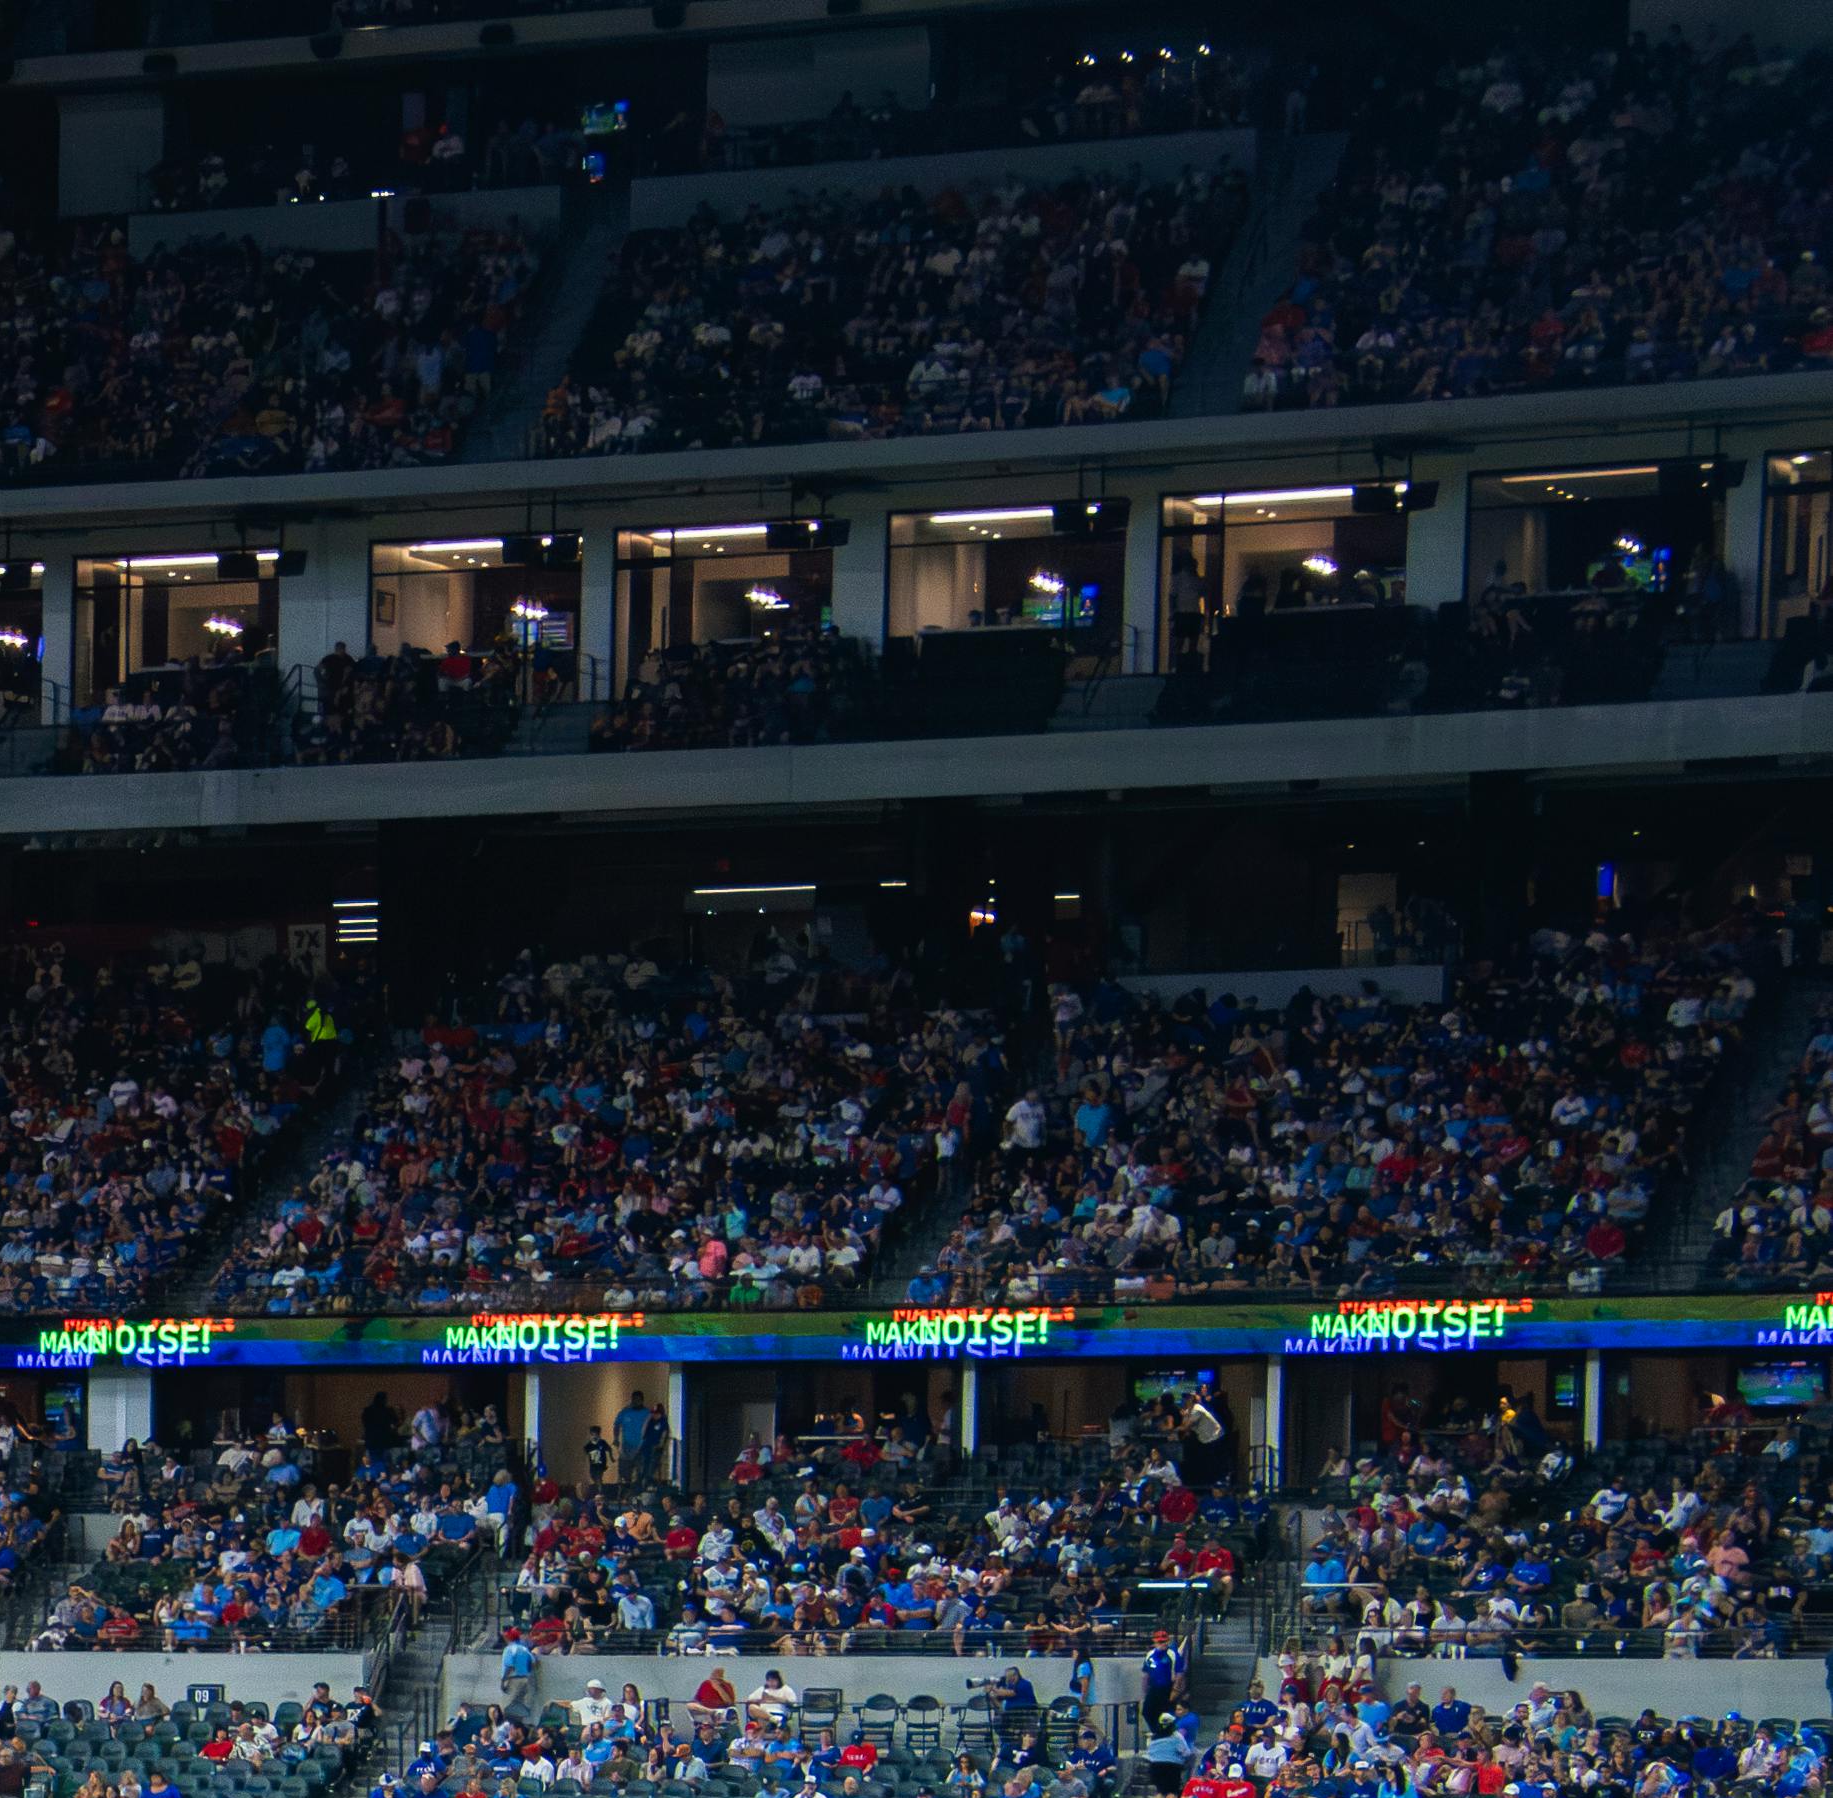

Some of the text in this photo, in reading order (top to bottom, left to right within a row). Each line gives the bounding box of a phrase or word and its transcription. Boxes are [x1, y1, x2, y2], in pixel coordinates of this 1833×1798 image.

[496, 1320, 619, 1350] NOISE!
[919, 1314, 1048, 1344] NOISE!
[1366, 1306, 1505, 1338] NOISE!
[88, 1325, 211, 1354] NOISE!
[195, 1690, 209, 1703] 09
